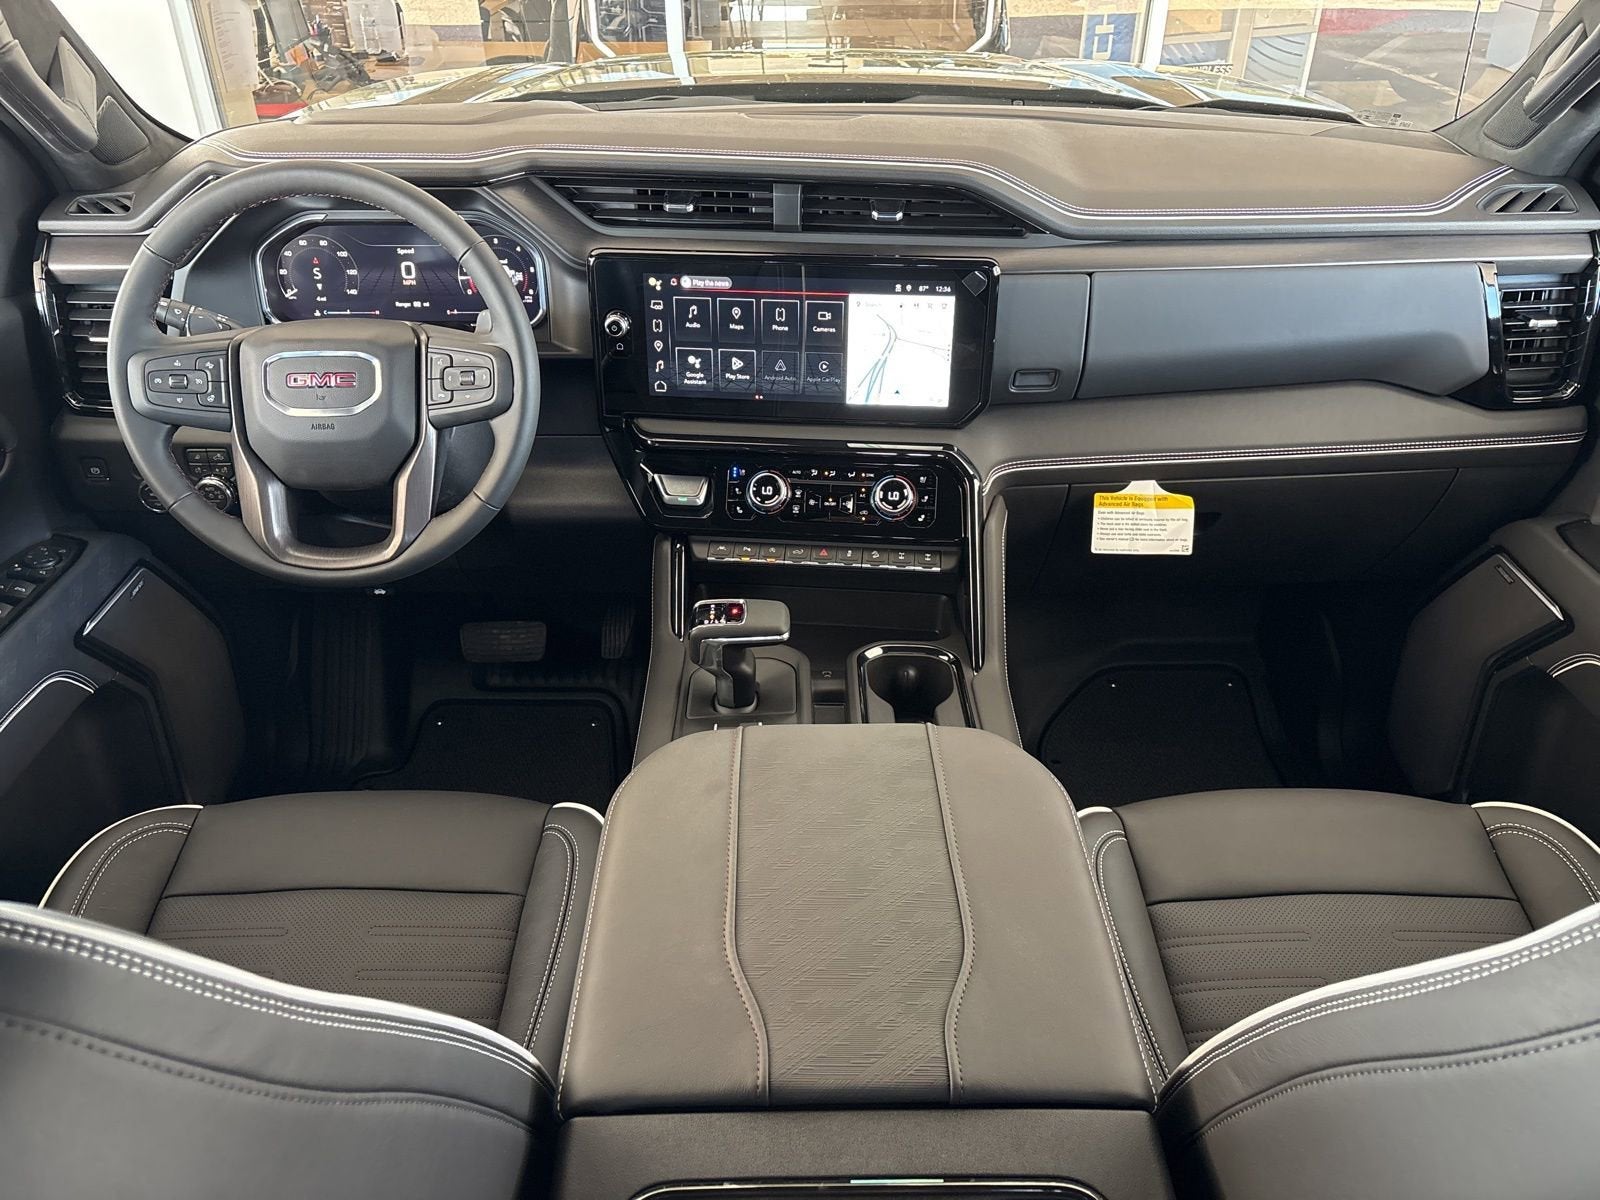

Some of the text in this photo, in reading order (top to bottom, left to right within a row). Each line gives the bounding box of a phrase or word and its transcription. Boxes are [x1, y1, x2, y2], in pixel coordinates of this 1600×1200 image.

[312, 267, 322, 280] S
[400, 261, 416, 279] 0
[692, 279, 730, 288] Play the news
[812, 325, 836, 333] Cameras
[686, 371, 704, 379] Google
[286, 372, 357, 388] GMC
[806, 376, 841, 384] Apple CarPlay
[311, 423, 335, 431] AIRBAG
[761, 486, 773, 495] LO
[888, 491, 899, 500] LO
